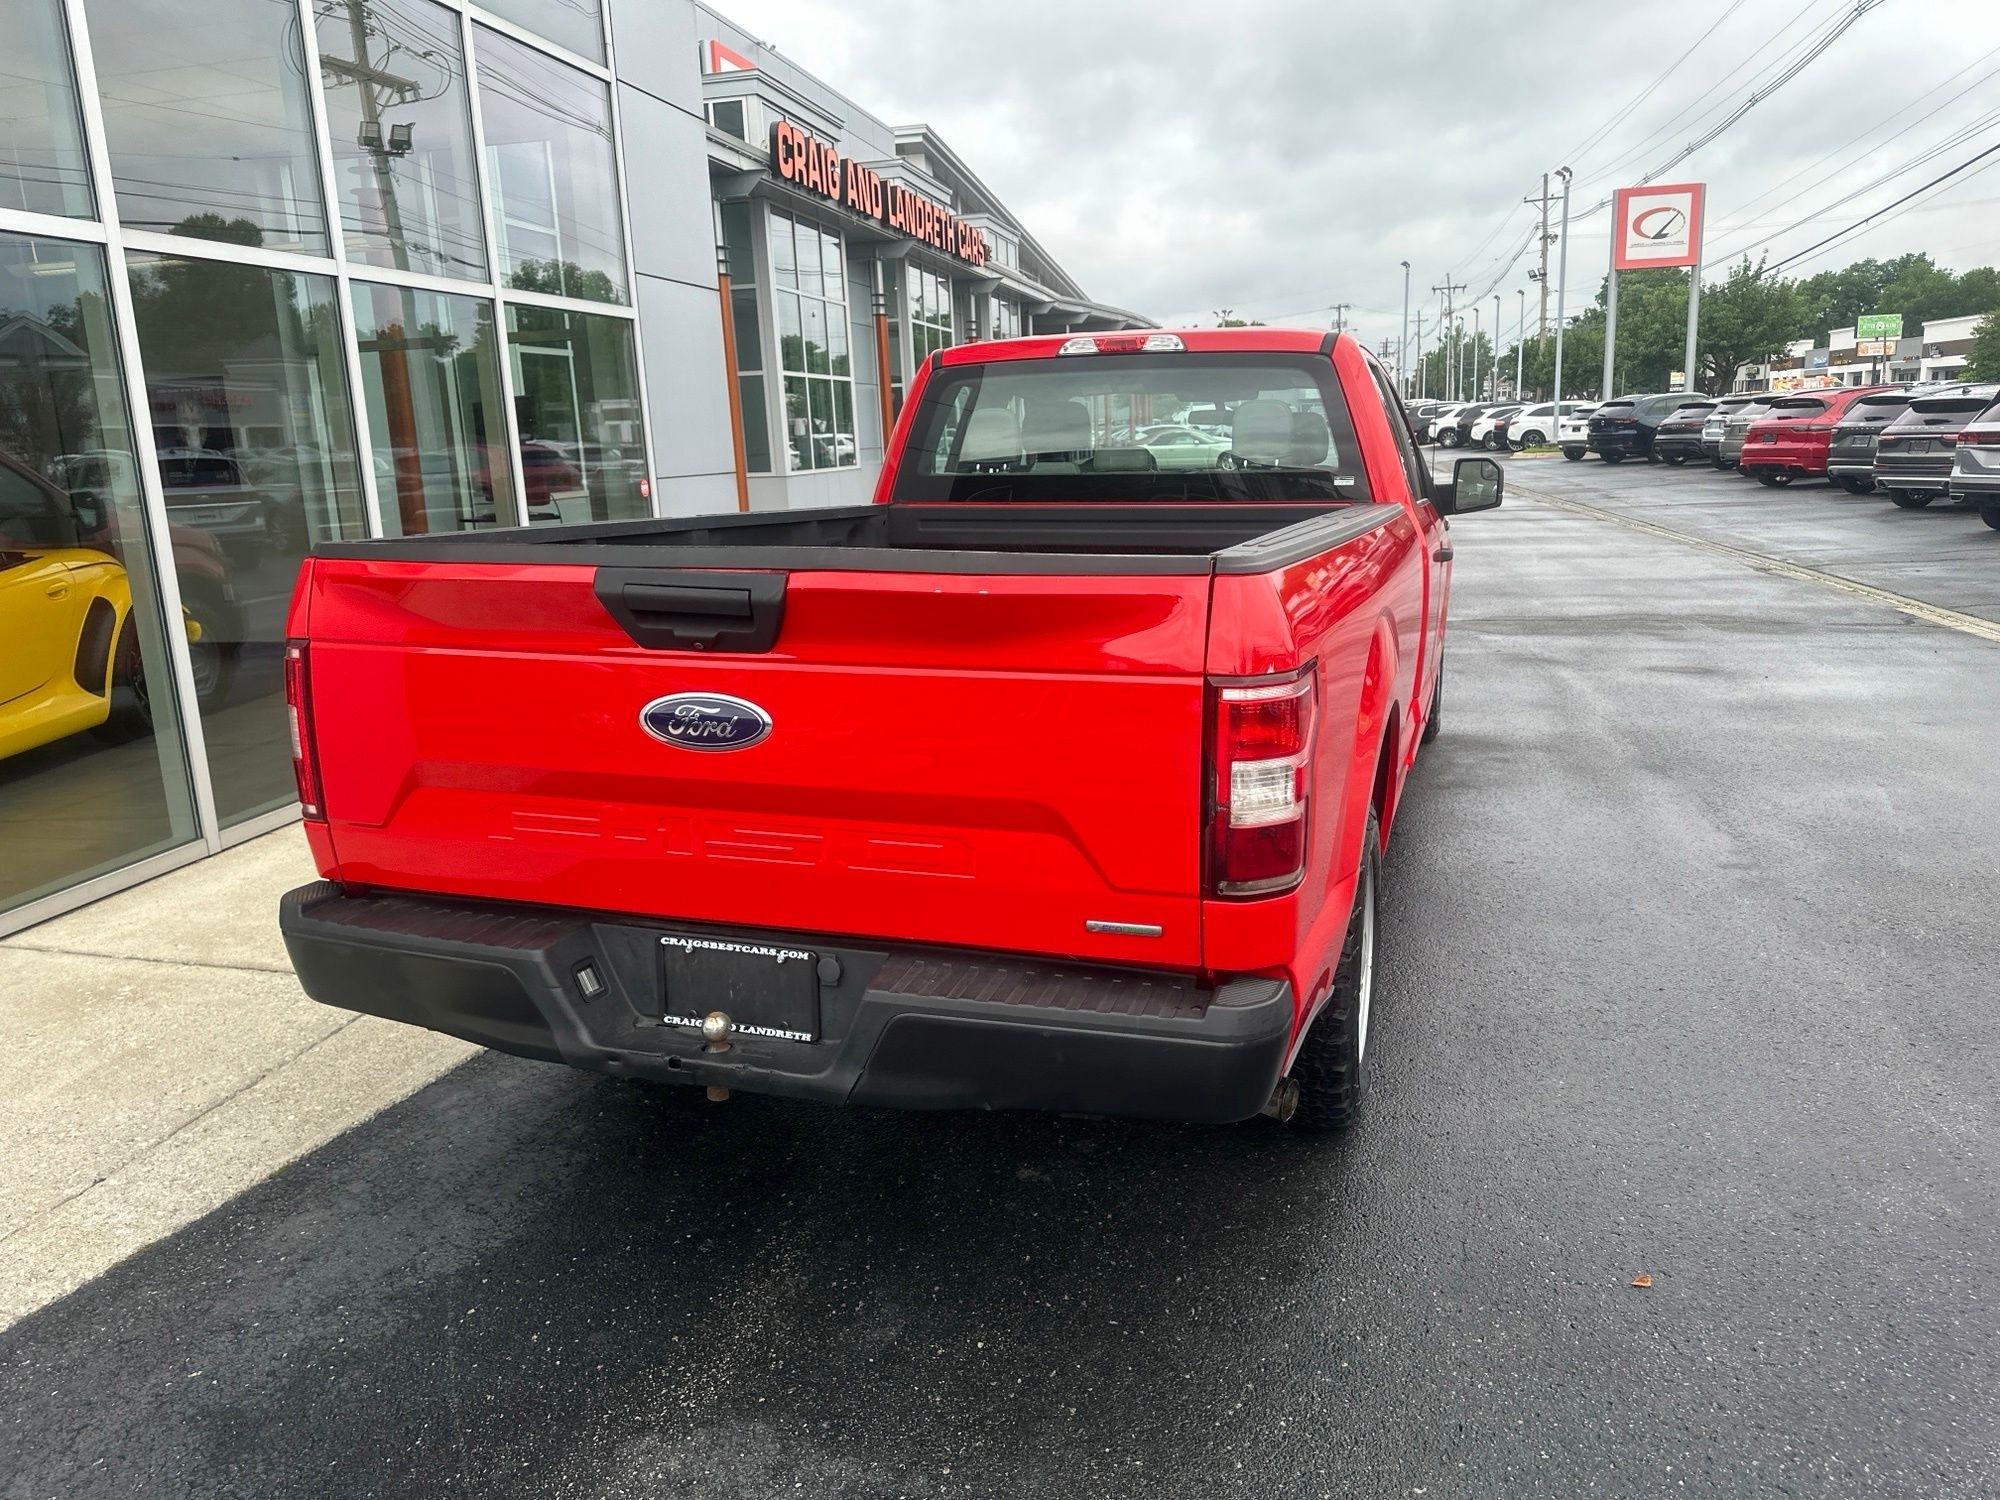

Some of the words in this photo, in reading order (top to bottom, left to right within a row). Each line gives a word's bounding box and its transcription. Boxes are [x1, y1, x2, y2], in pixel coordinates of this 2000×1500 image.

[776, 120, 840, 200] CRAIG
[847, 158, 882, 220] AND
[887, 180, 955, 254] LANDRETH
[957, 219, 985, 267] CARS
[668, 704, 738, 738] Ford
[660, 936, 809, 960] CRAIGSBESTCARS.COM
[739, 1024, 811, 1042] LANDRETH
